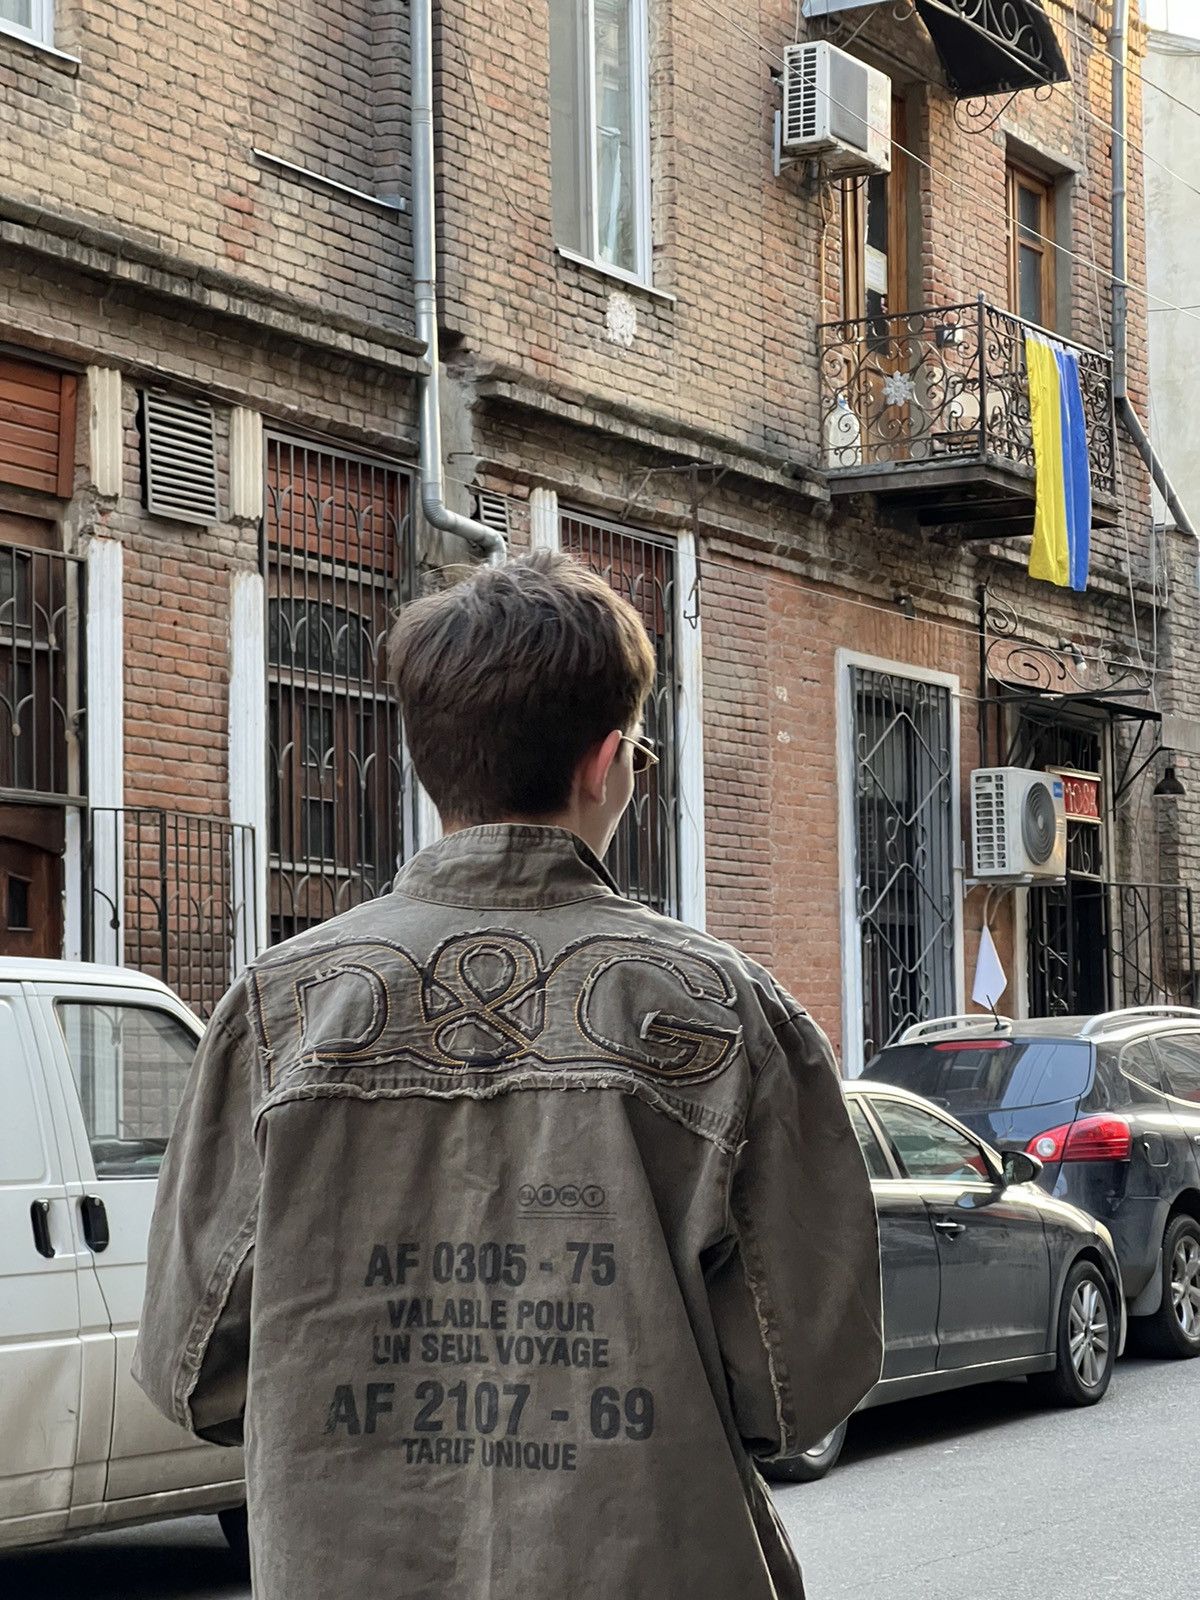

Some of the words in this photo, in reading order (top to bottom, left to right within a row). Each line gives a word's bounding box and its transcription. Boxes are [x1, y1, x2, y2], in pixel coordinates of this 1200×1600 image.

[249, 926, 743, 1089] D&G
[364, 1243, 420, 1287] AF
[432, 1241, 526, 1287] 0305
[566, 1241, 616, 1286] 75
[388, 1299, 507, 1330] VALABLE
[517, 1301, 595, 1331] POUR
[372, 1334, 411, 1365] UN
[421, 1334, 489, 1363] SEUL
[496, 1336, 610, 1368] VOYAGE
[324, 1382, 395, 1434] AF
[413, 1380, 531, 1435] 2107
[590, 1386, 655, 1441] 69
[402, 1437, 476, 1466] TARIF
[481, 1440, 577, 1471] UNIQUE
